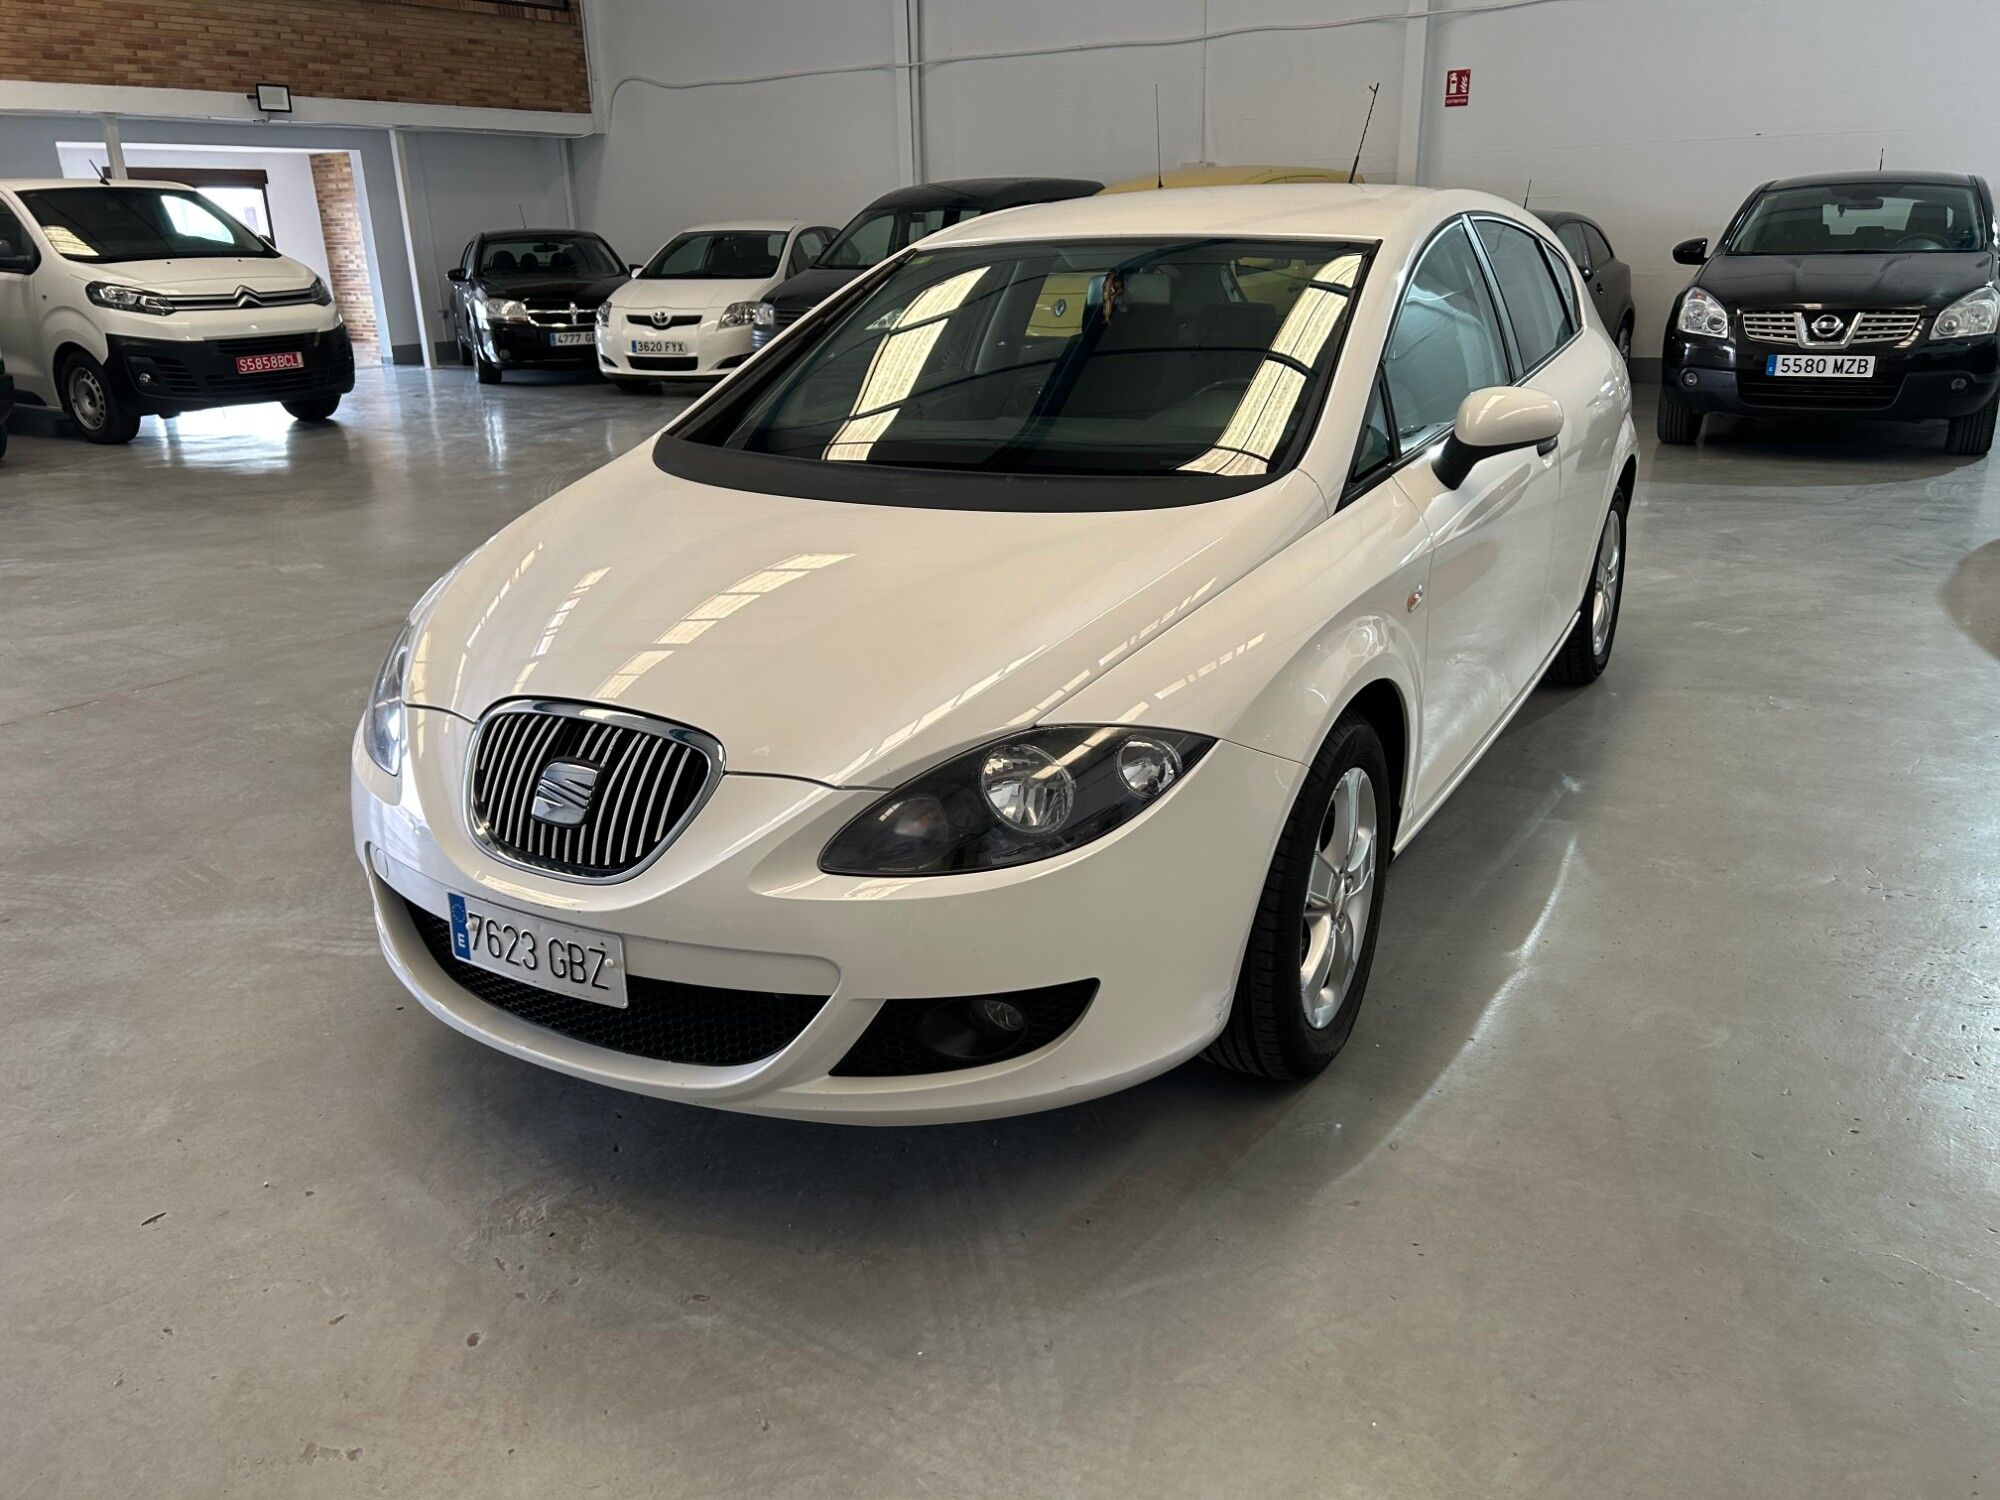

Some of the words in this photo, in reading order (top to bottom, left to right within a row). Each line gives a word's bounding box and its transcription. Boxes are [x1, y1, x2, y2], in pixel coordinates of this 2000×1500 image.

[558, 333, 581, 344] 4777
[638, 341, 662, 352] 3620
[665, 342, 684, 352] FYX
[240, 355, 298, 371] S5858BCL
[1780, 358, 1826, 373] 5580
[1832, 358, 1869, 374] MZB
[457, 932, 466, 948] E
[468, 912, 538, 971] 7623
[548, 937, 610, 991] GBZ
